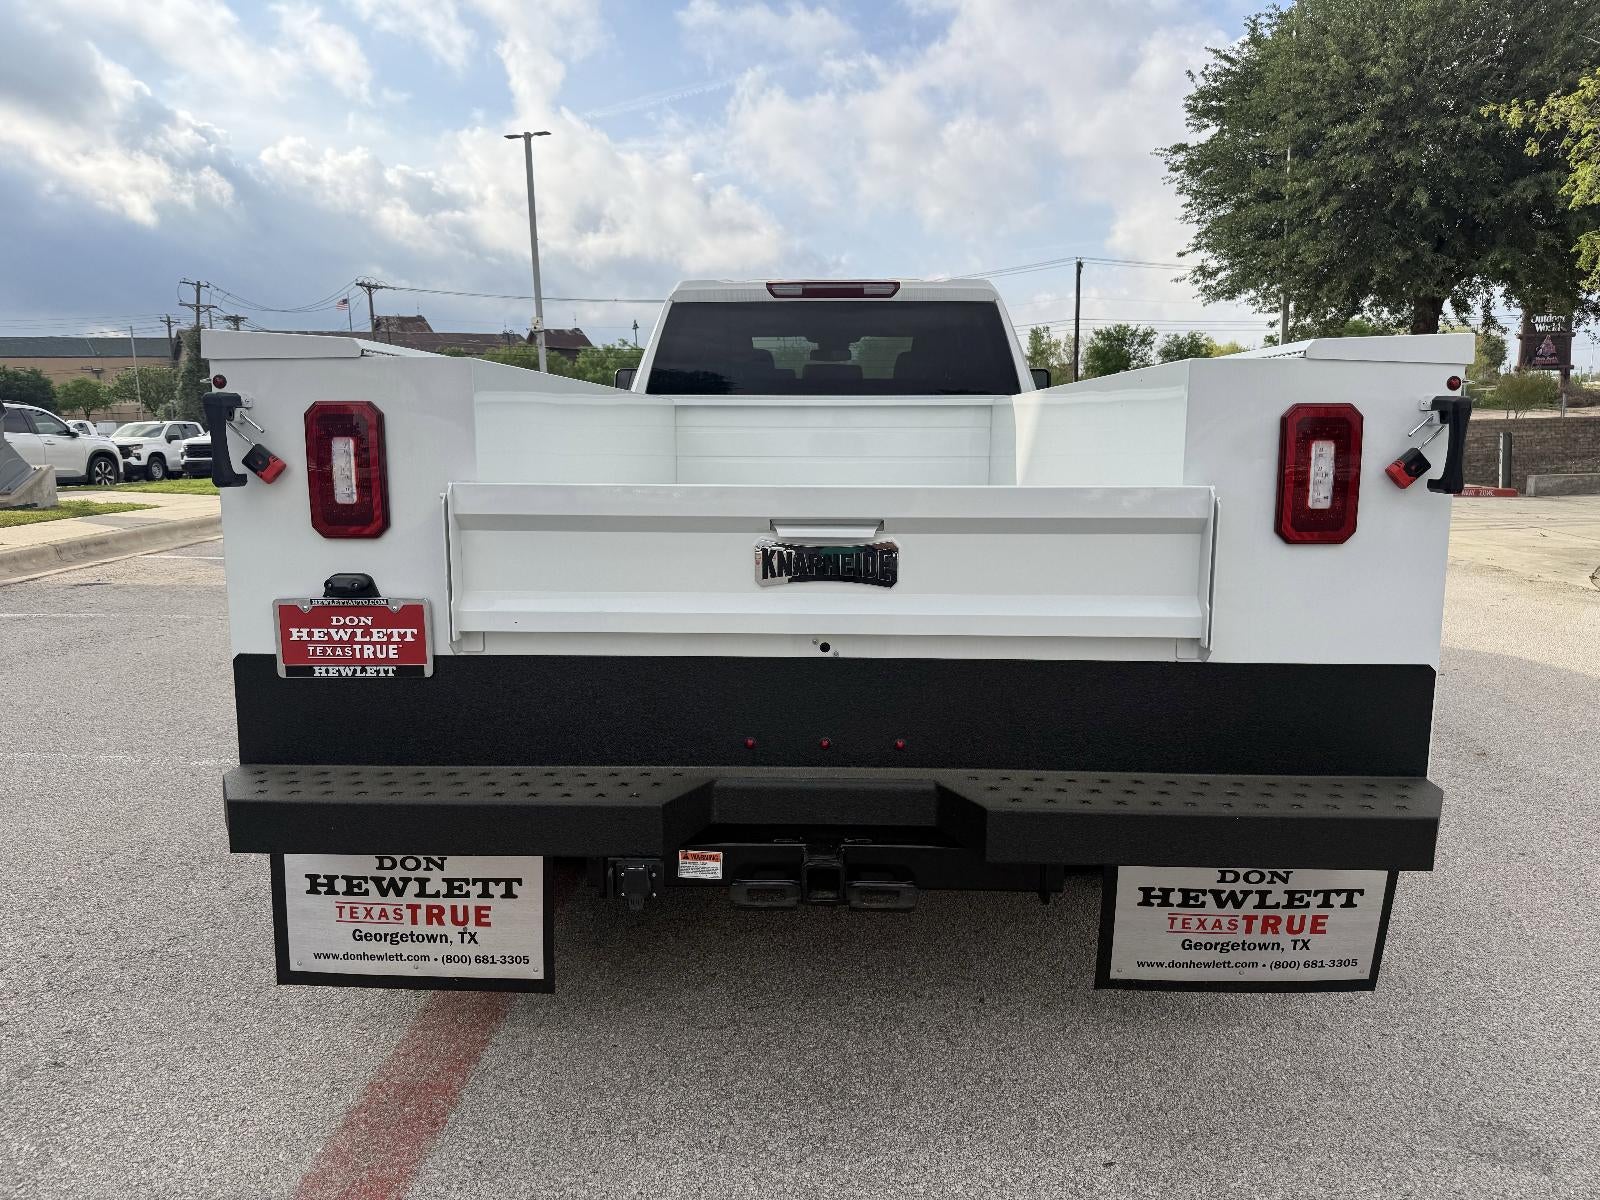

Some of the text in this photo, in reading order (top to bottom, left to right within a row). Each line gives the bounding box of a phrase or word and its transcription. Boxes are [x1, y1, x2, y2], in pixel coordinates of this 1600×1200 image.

[761, 546, 895, 582] KNAPHEIDE
[330, 616, 374, 626] DON
[288, 627, 418, 642] HEWLETT
[313, 665, 397, 677] HEWLETT
[375, 855, 448, 872] DON
[1216, 869, 1294, 885] DON
[304, 873, 523, 900] HEWLETT
[1136, 886, 1365, 910] HEWLETT
[352, 928, 480, 947] Georgetown, TX
[1181, 938, 1312, 954] Georgetown, TX
[313, 950, 530, 966] www.donhewlett.com (800) 681-3305
[1136, 958, 1359, 971] www.donhewlett.com (800) 681-3305
